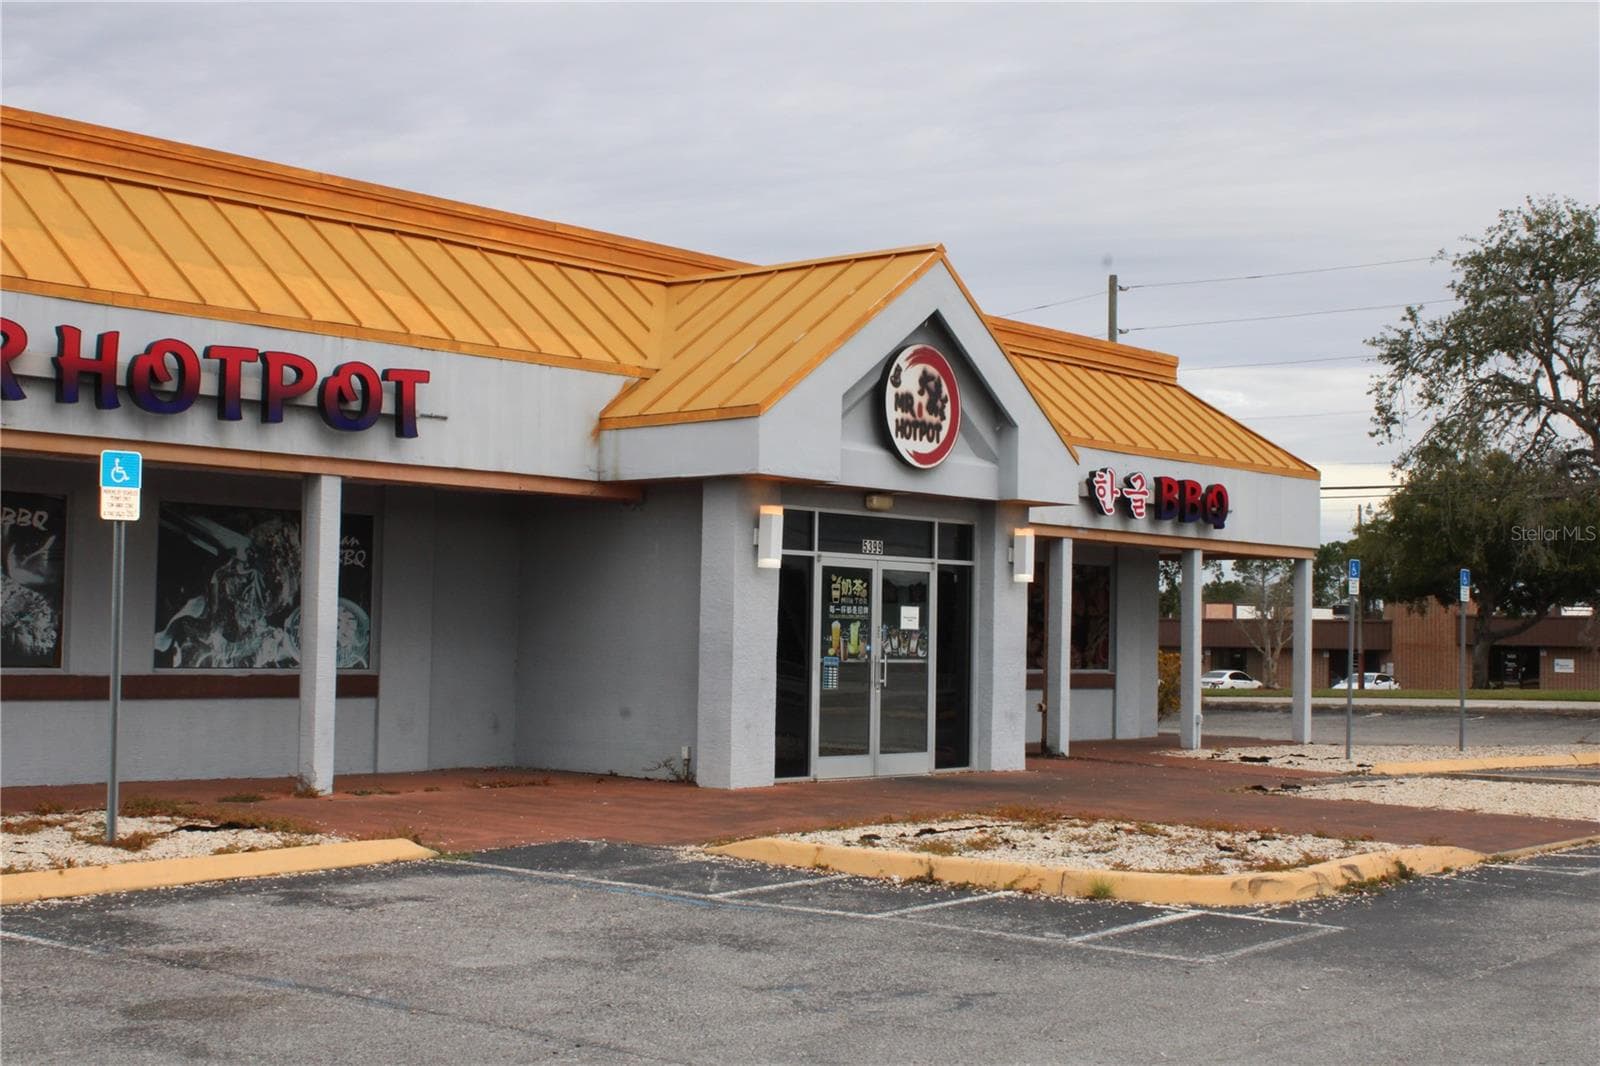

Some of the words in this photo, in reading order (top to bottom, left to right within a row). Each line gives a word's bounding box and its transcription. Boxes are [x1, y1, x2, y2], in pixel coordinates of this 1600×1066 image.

[52, 324, 430, 439] HOTPOT
[895, 417, 943, 444] HOTPOT
[1, 506, 49, 531] BBQ
[1086, 467, 1150, 519] 한글
[1153, 476, 1229, 530] BBQ
